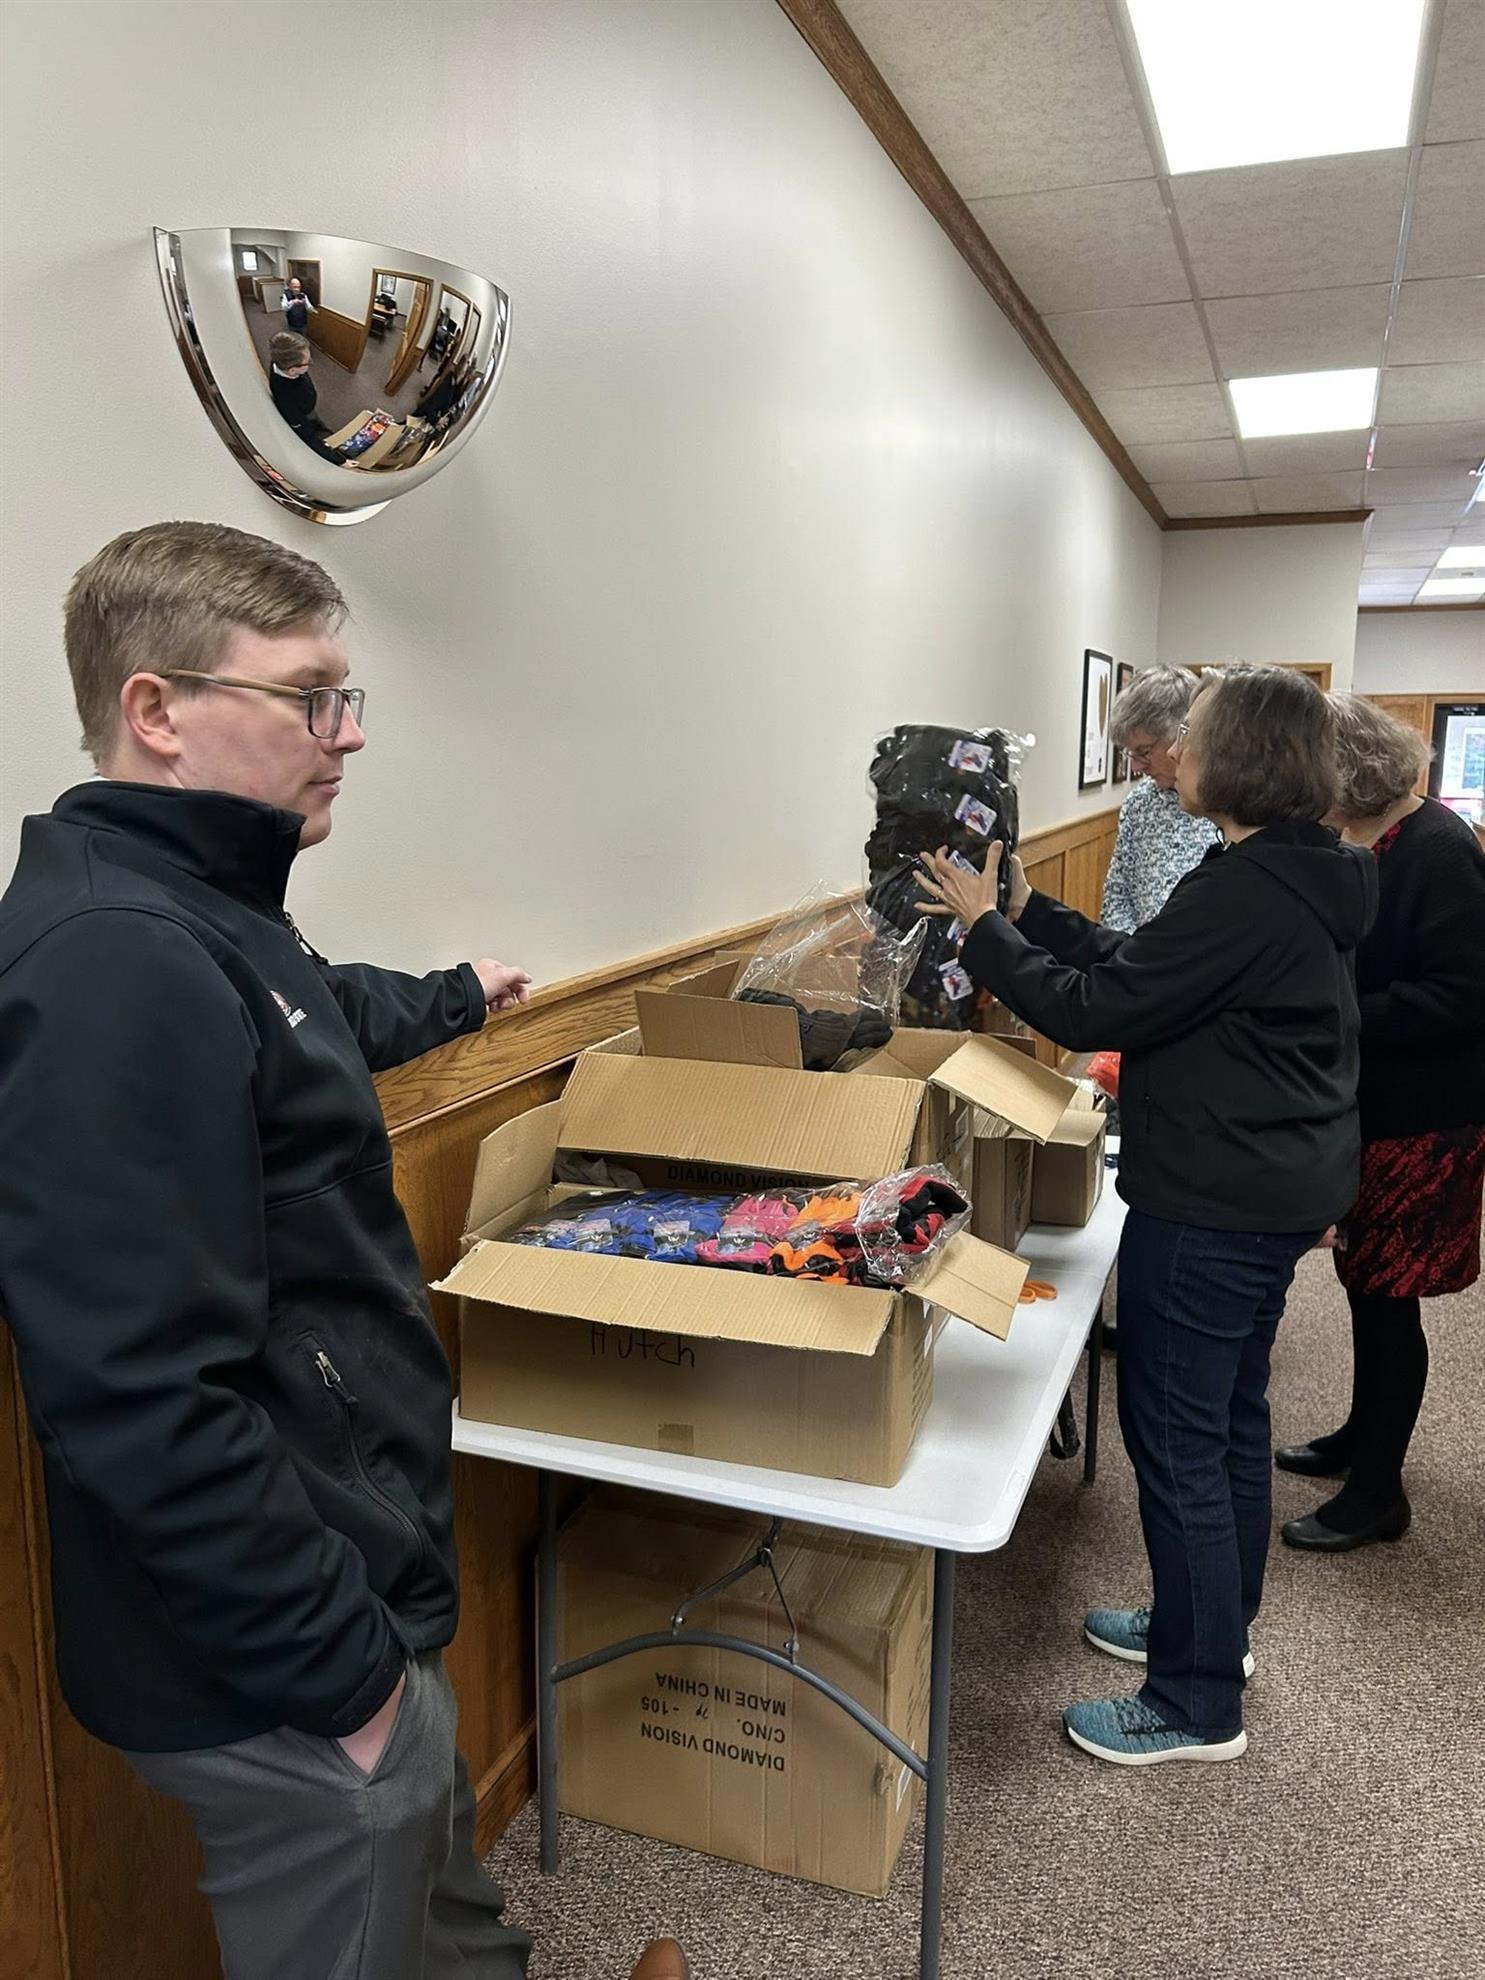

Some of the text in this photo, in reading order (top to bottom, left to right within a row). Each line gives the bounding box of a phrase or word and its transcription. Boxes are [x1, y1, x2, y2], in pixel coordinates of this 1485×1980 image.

[667, 1165, 746, 1188] DIAMOND
[656, 1672, 786, 1717] MADE IN CHINA
[641, 1721, 785, 1772] DIAMOND VISION
[737, 1718, 785, 1744] C/NO.
